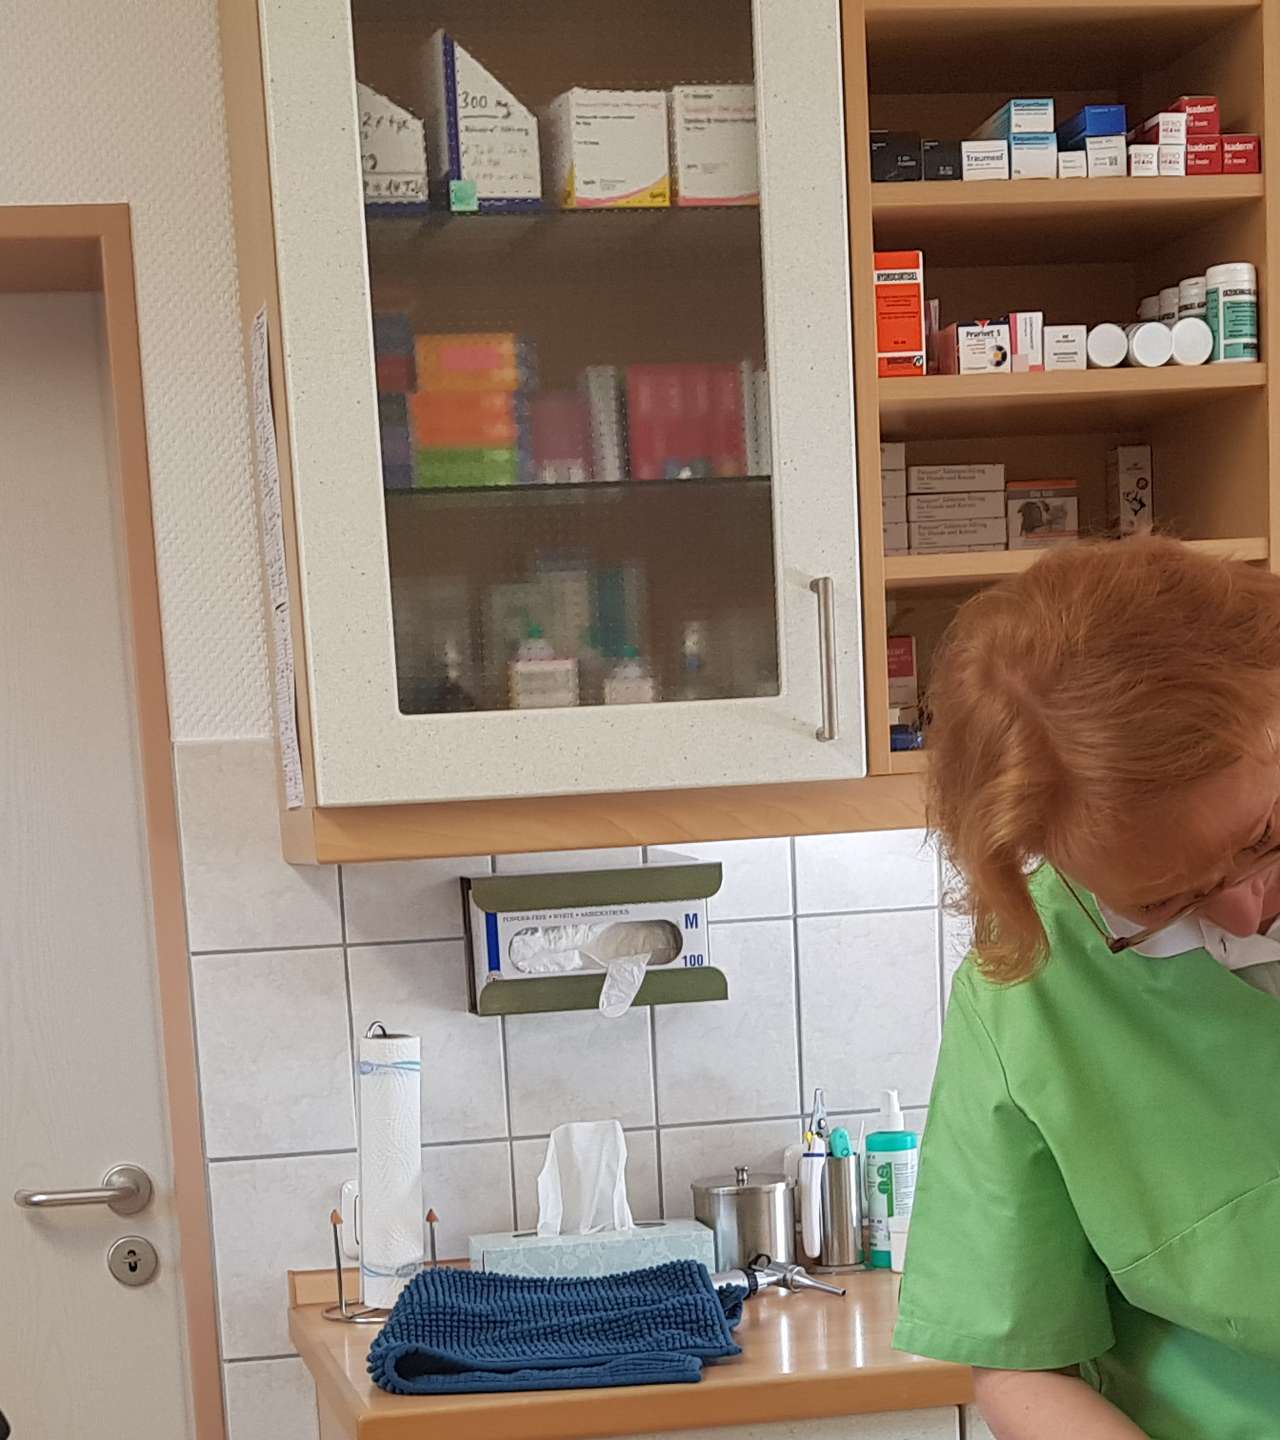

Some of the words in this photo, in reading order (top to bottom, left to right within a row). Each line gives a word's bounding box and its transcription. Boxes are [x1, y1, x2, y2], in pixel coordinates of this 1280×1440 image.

[460, 91, 487, 109] 300
[684, 913, 699, 929] M
[683, 953, 704, 968] 100
